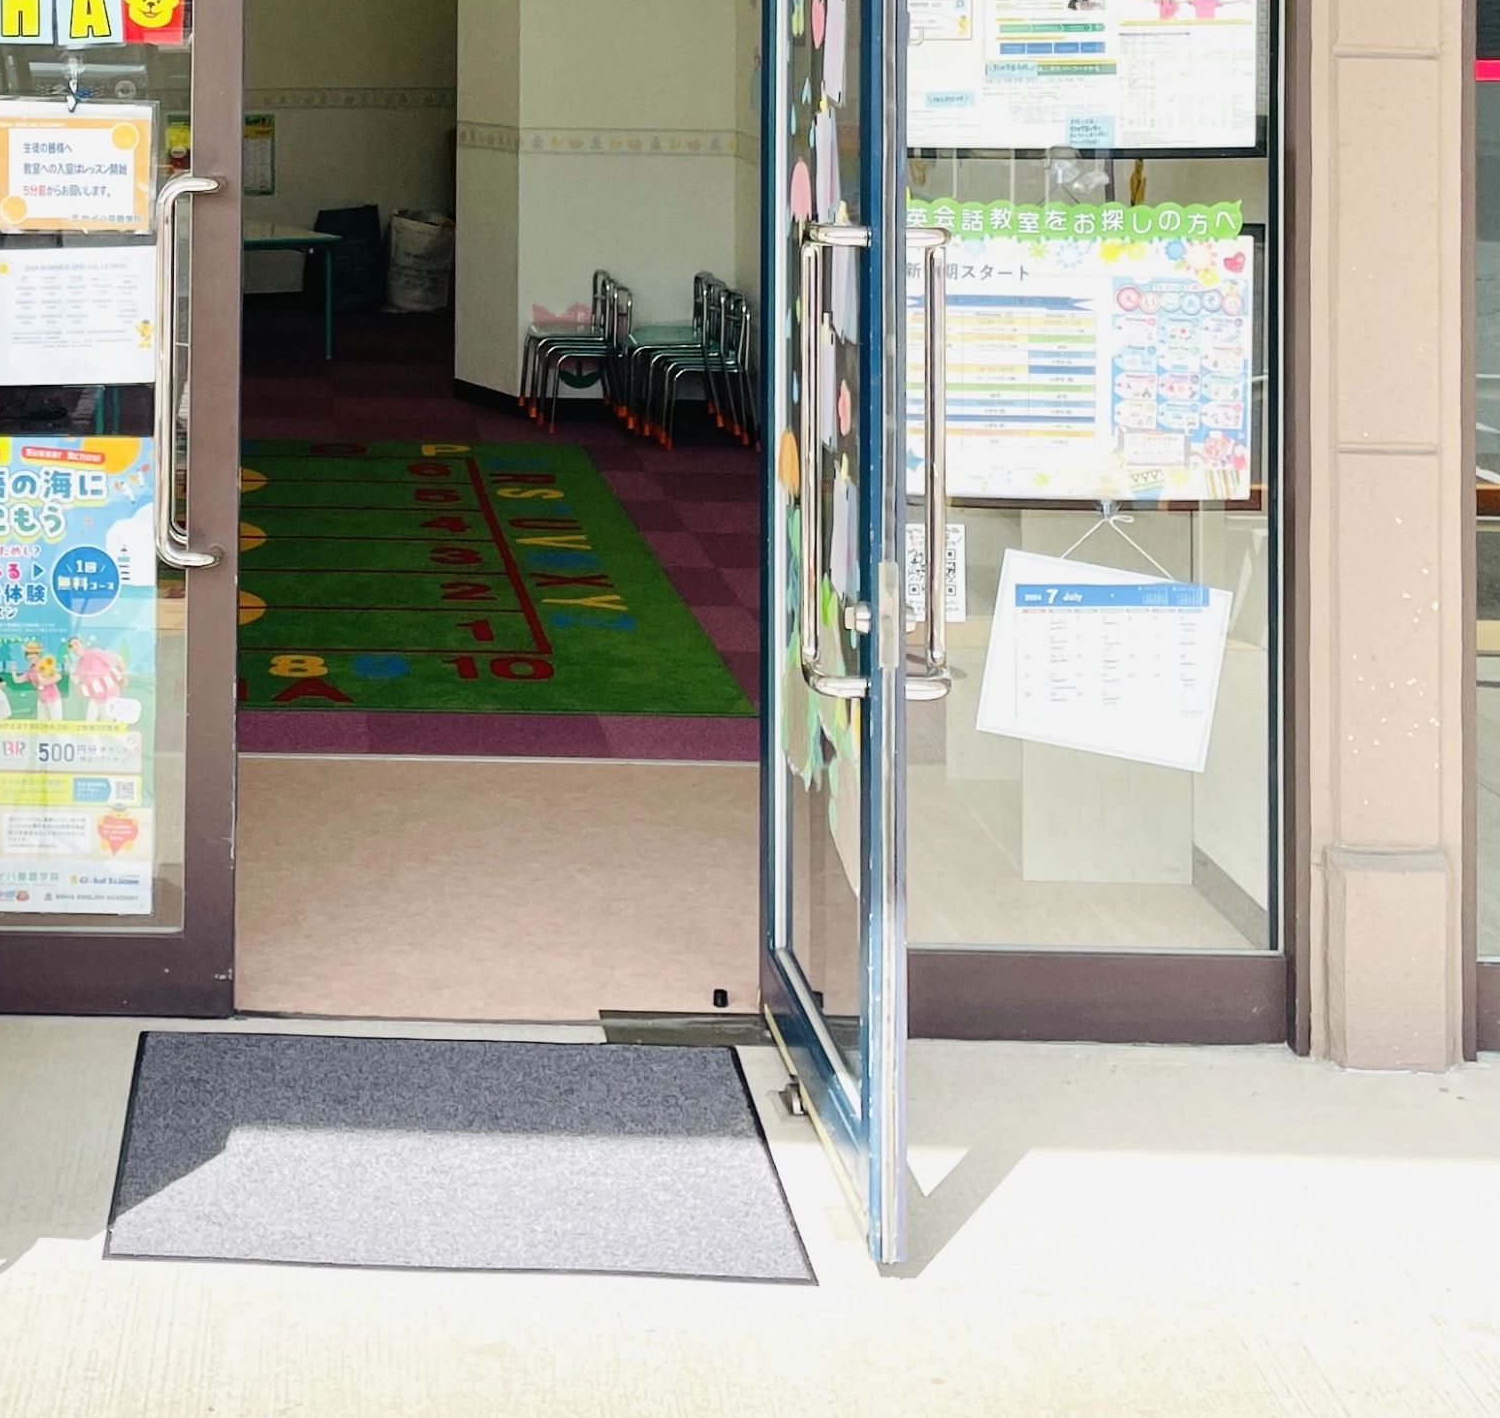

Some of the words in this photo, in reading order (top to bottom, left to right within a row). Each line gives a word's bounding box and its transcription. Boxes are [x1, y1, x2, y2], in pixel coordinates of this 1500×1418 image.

[906, 207, 1237, 234] 英会話教室をお探しの方へ
[906, 262, 1030, 281] 新期スタート
[76, 559, 98, 574] 1回
[1045, 588, 1059, 604] 7
